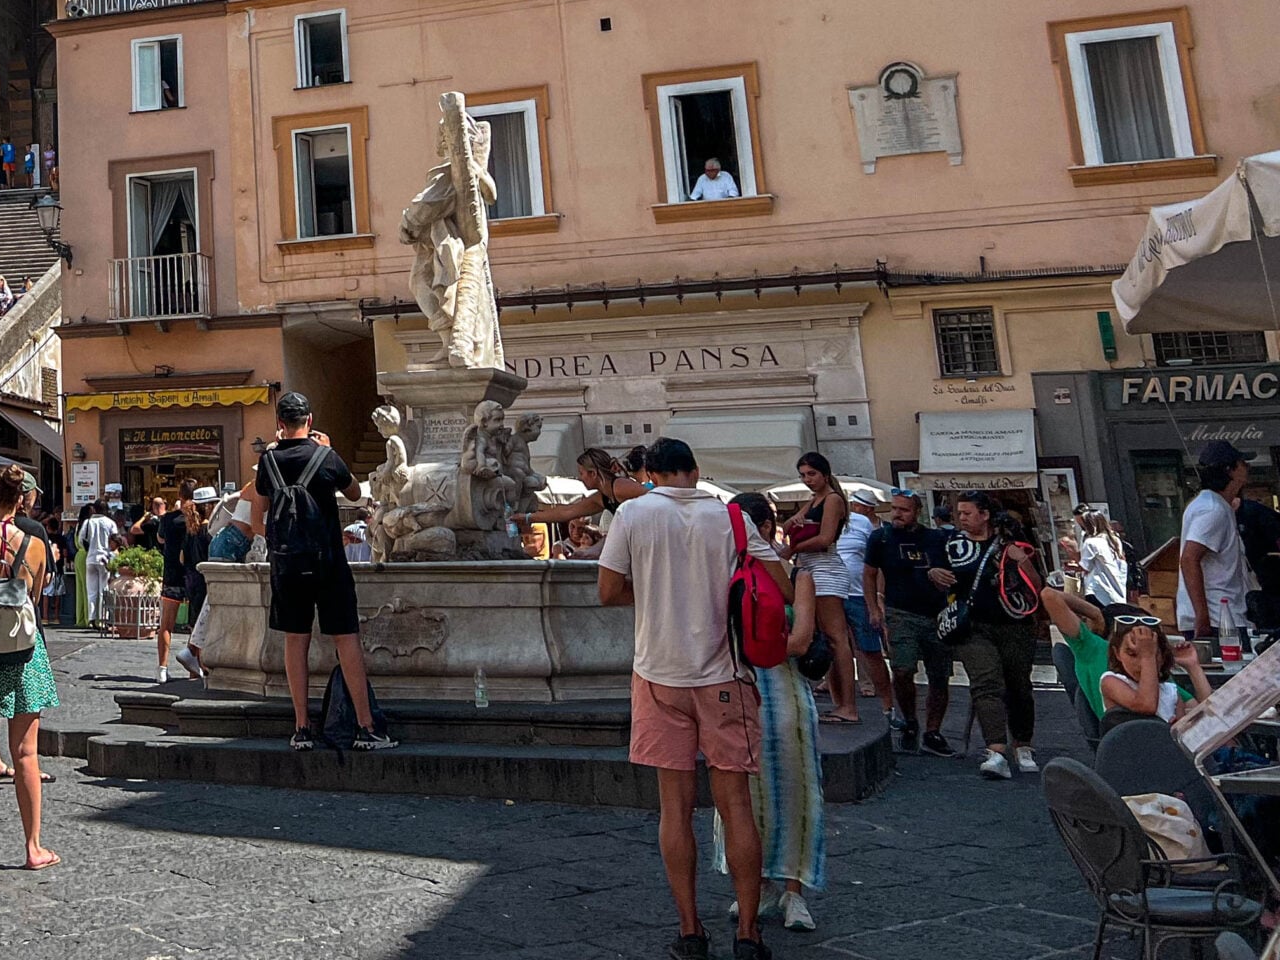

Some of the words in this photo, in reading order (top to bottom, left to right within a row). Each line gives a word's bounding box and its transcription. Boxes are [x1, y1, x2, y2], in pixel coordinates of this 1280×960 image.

[504, 353, 619, 379] NDREA
[648, 344, 781, 374] PANSA
[932, 384, 944, 395] La
[981, 383, 993, 393] del
[1122, 372, 1279, 404] FARMAC
[150, 428, 211, 442] Limoncello
[1184, 423, 1265, 444] Medaglia
[933, 478, 945, 489] La
[937, 616, 958, 640] 1995
